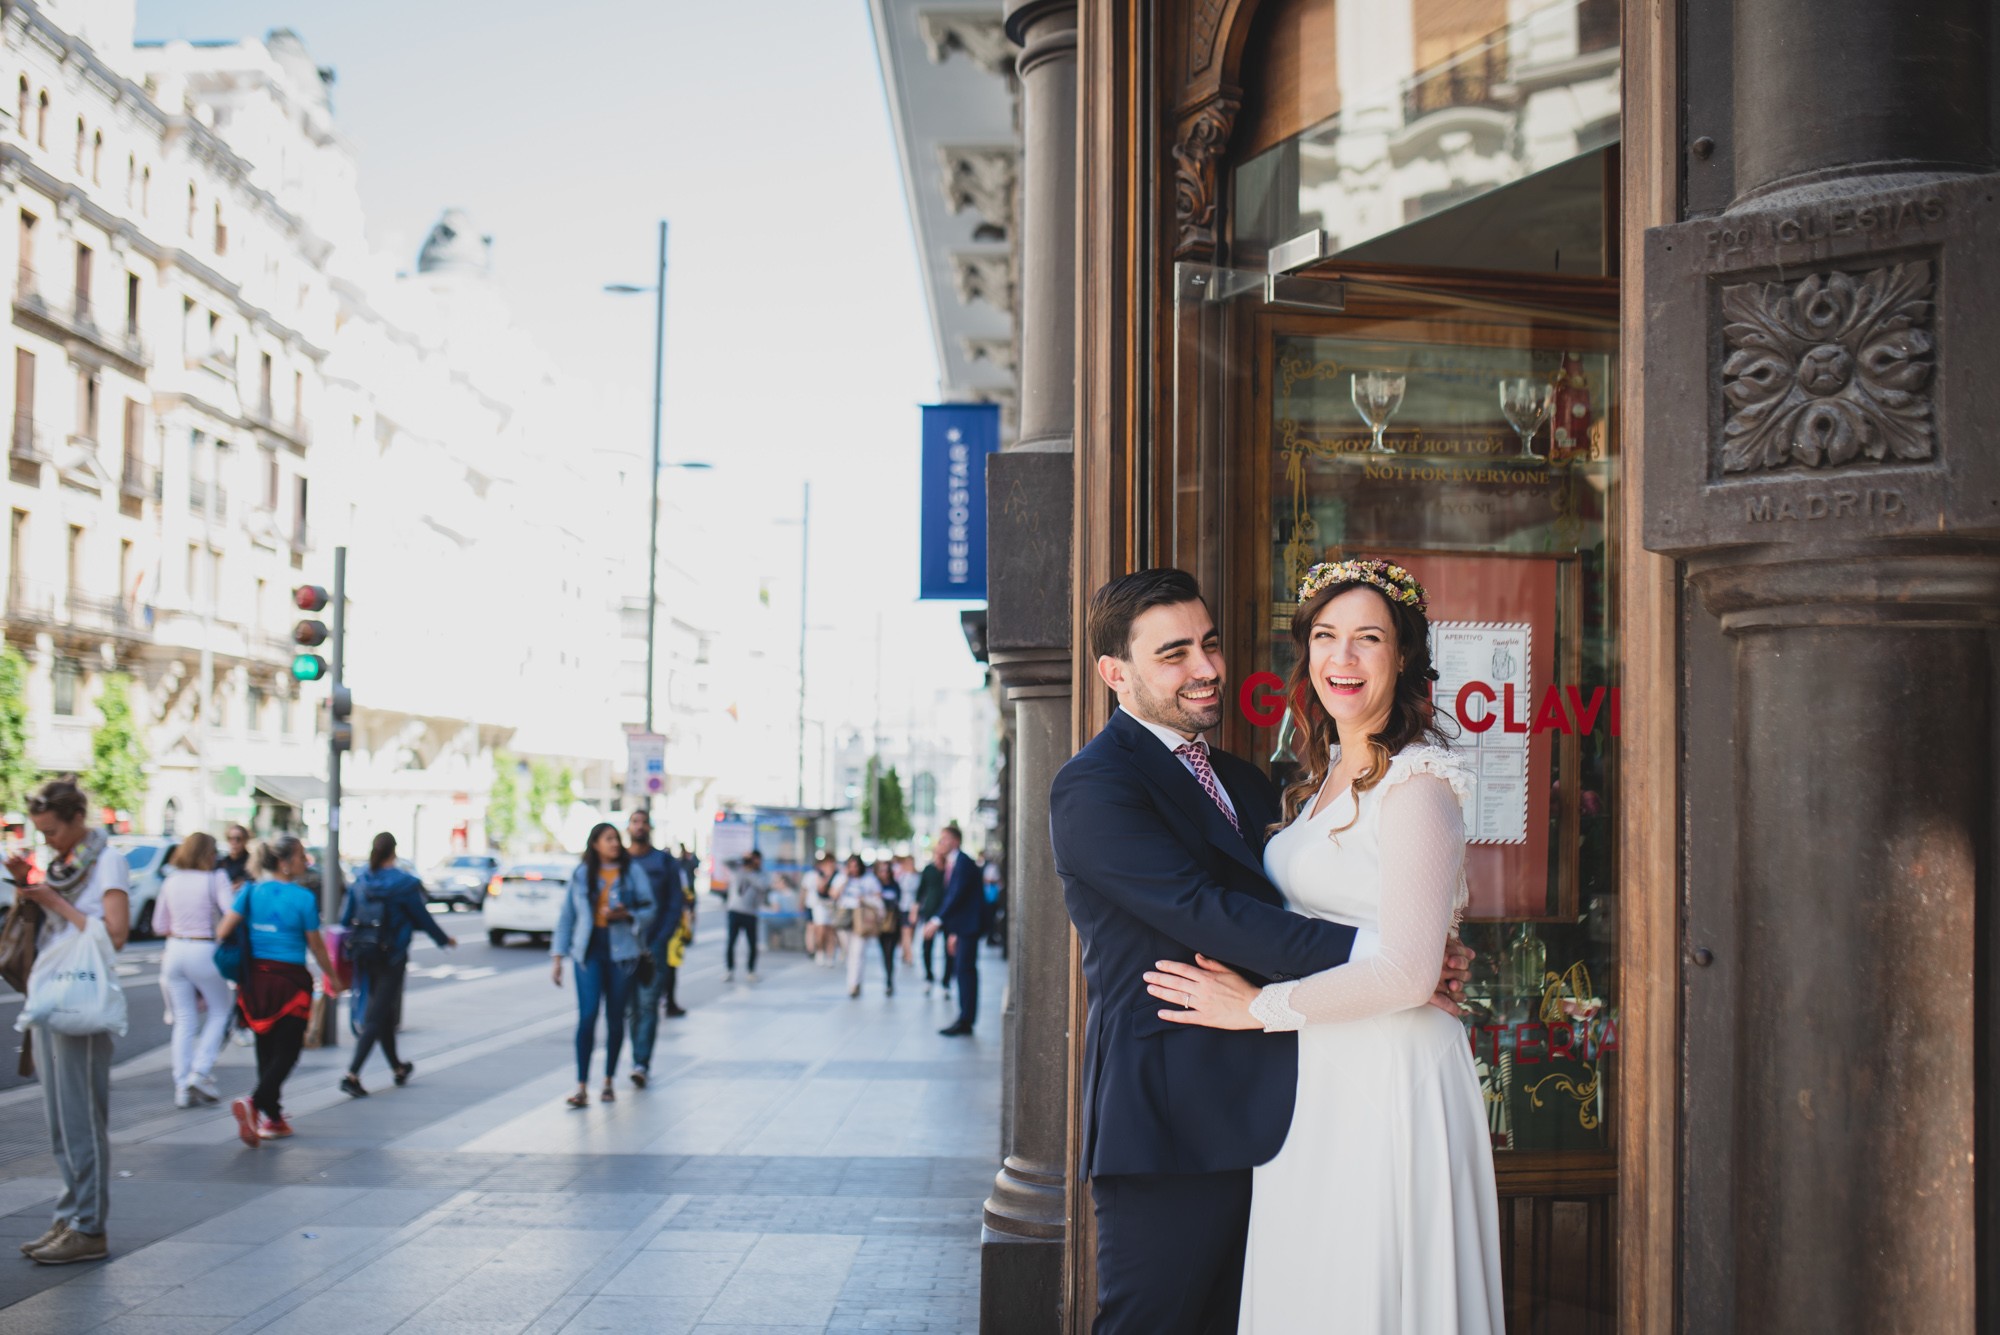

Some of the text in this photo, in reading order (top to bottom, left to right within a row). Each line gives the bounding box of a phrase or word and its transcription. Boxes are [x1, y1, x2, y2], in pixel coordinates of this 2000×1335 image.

[1771, 197, 1945, 242] IGLESIAS
[1365, 464, 1550, 484] NOT FOR EVERYONE
[947, 443, 969, 583] IBEROSTAR
[1747, 489, 1904, 522] MADRID
[1444, 634, 1483, 642] APERITIVO
